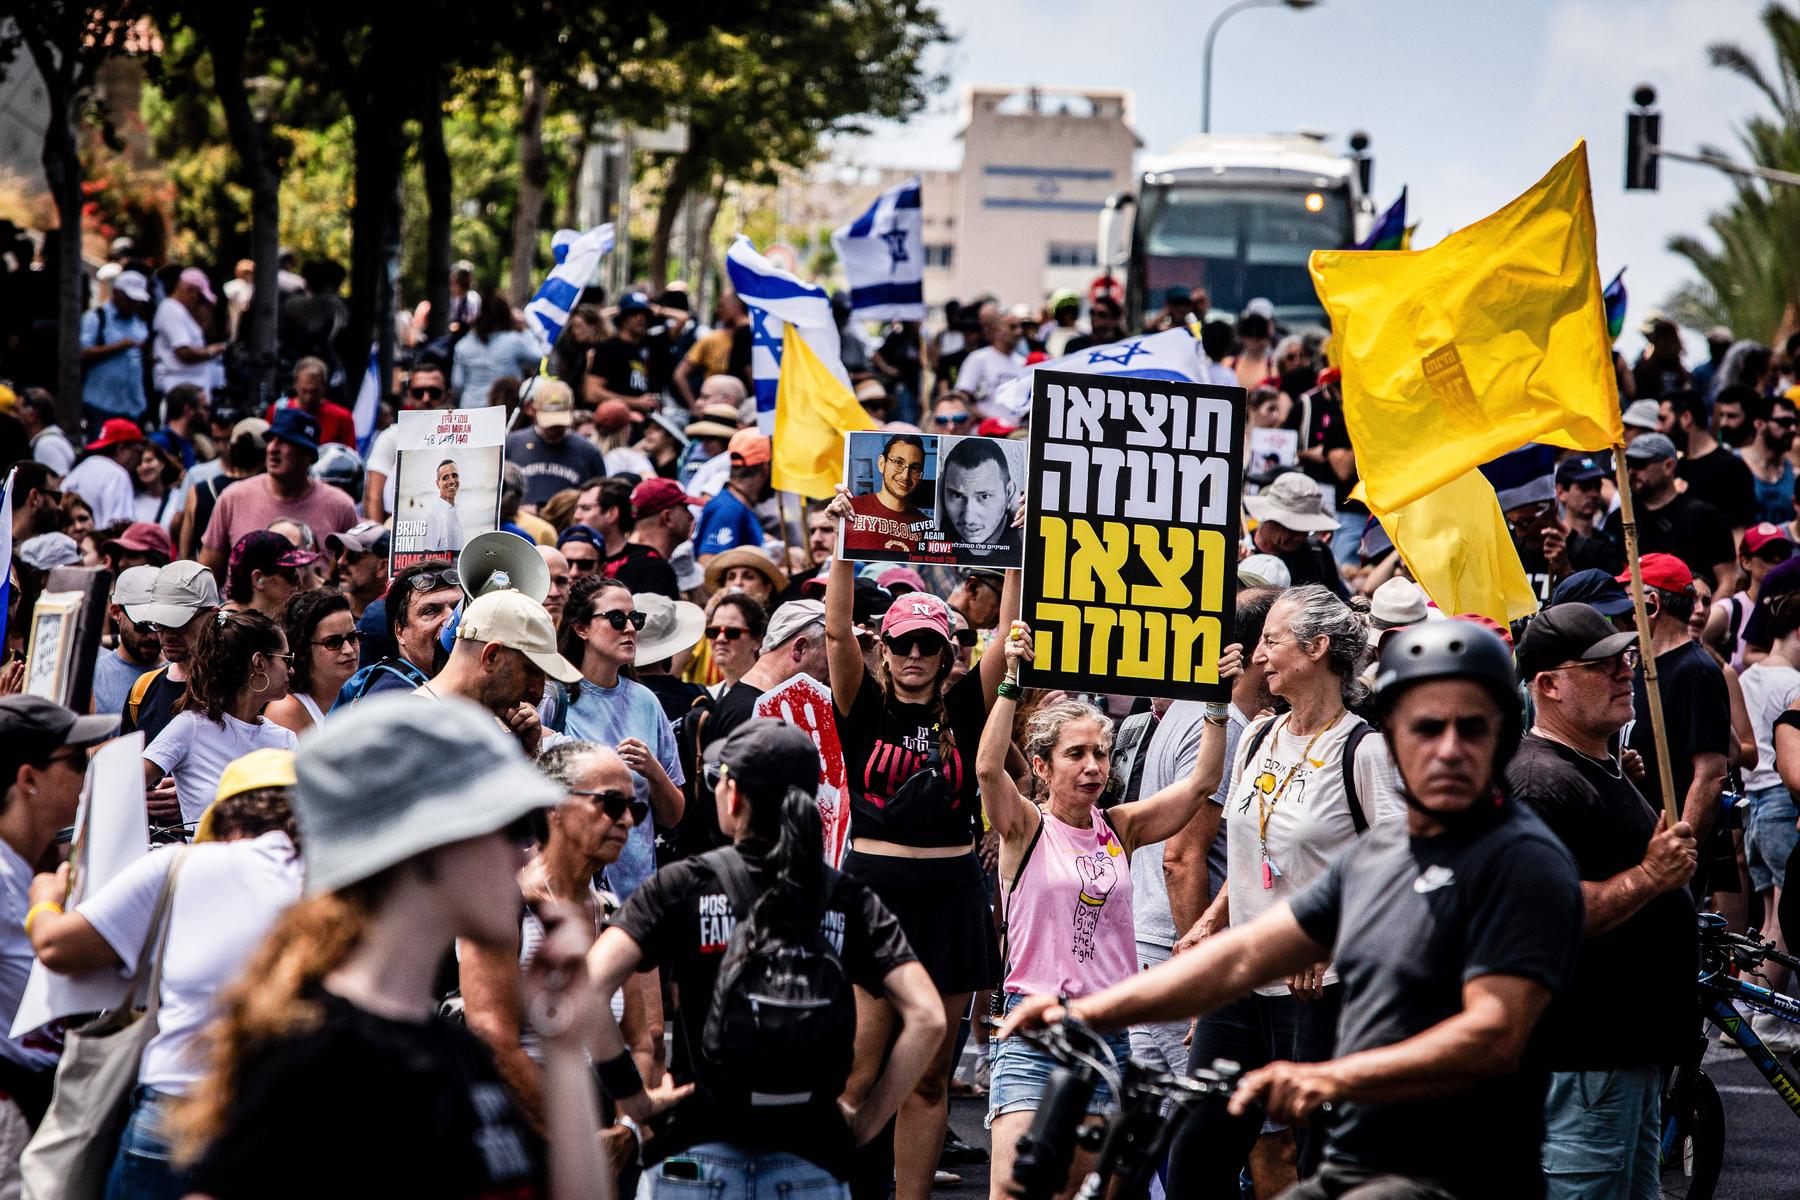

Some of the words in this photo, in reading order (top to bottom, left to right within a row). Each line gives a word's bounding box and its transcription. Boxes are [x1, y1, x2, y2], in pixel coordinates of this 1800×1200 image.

[1047, 384, 1232, 453] תוציאו
[452, 424, 471, 433] MIRAN
[1041, 442, 1230, 526] מעזה
[396, 520, 427, 536] BRING
[853, 514, 922, 541] HYDRO
[910, 520, 935, 532] NEVER
[924, 531, 945, 540] AGAIN
[395, 536, 415, 552] HIM
[918, 542, 926, 551] IS
[928, 542, 951, 553] NOW!
[1040, 516, 1226, 612] וצאו
[912, 603, 930, 616] N
[1034, 602, 1222, 684] מעזה
[699, 894, 733, 916] HOS
[700, 916, 737, 946] FAM
[1077, 918, 1094, 930] give
[1073, 933, 1089, 947] the
[1072, 943, 1095, 963] fight
